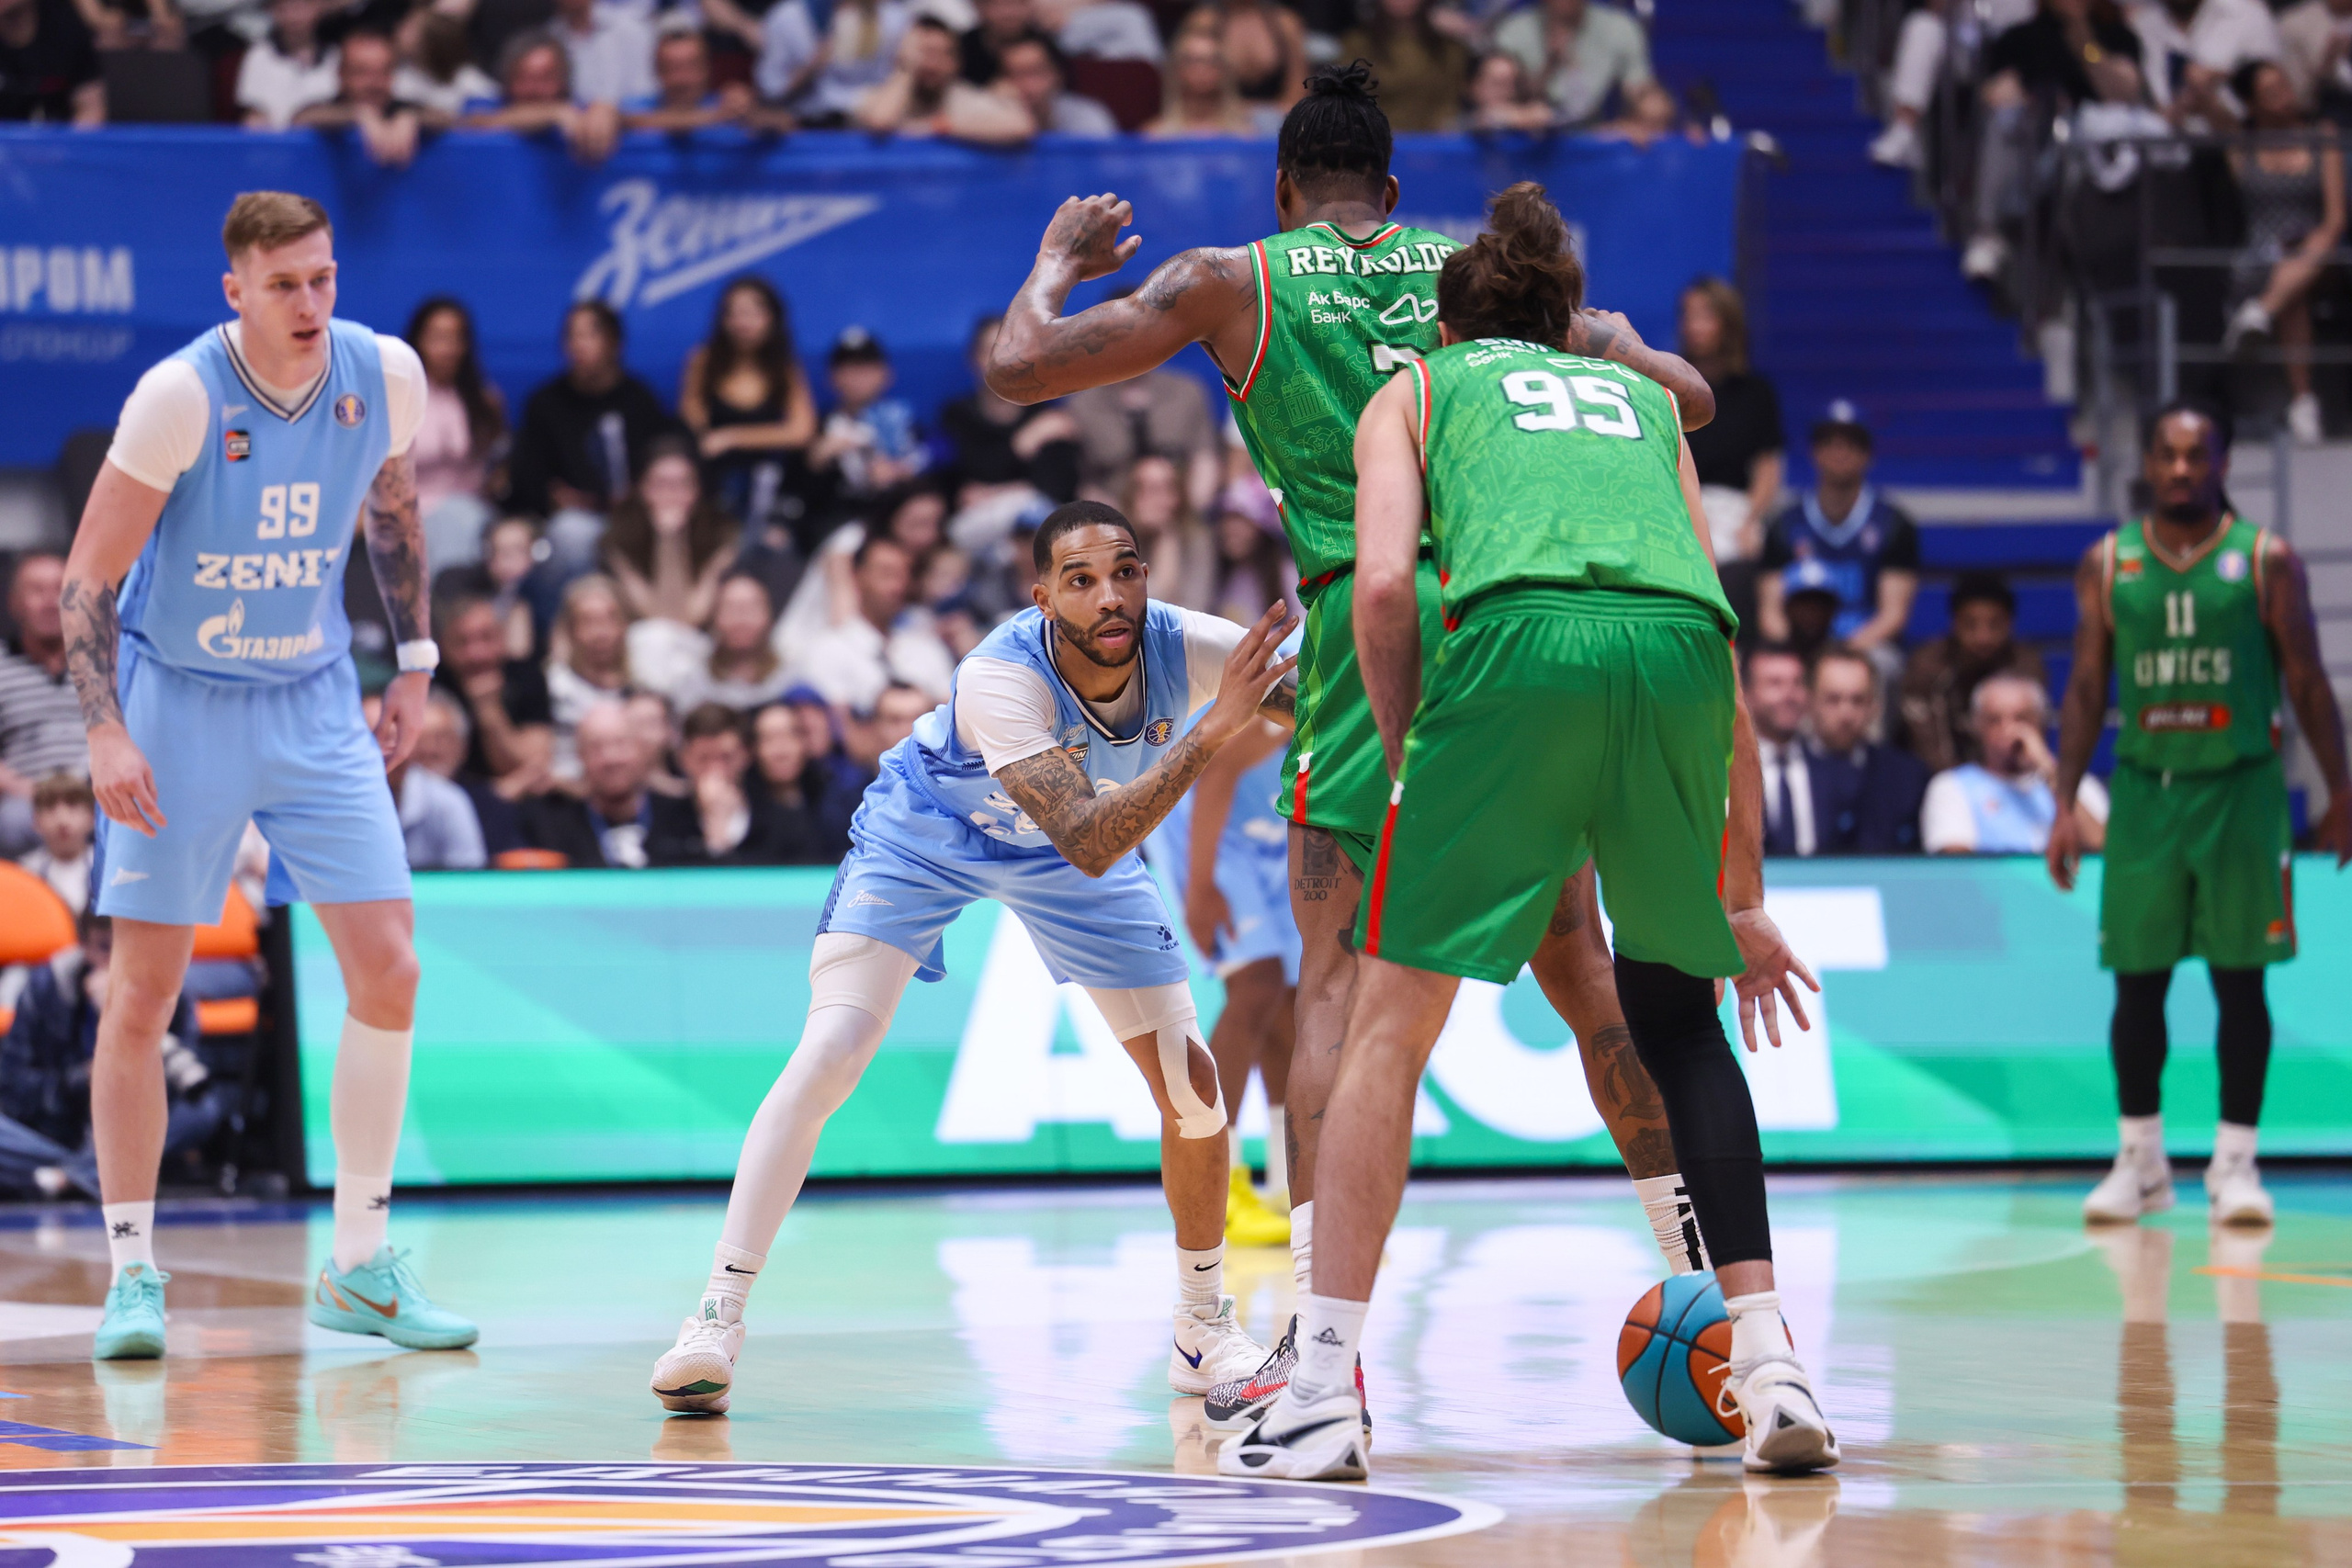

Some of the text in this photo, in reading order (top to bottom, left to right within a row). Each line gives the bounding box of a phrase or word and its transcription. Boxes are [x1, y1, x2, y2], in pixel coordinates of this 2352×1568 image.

[0, 246, 136, 313] РОМ
[1308, 290, 1371, 310] Ак Барс
[1311, 309, 1352, 324] Банк
[1499, 370, 1645, 441] 95
[257, 482, 320, 539] 99
[2165, 590, 2195, 637] 11
[241, 626, 323, 660] ГАЗПР
[2134, 647, 2232, 687] UNICS
[1295, 876, 1341, 889] DETROIT
[1303, 890, 1328, 901] ZOO
